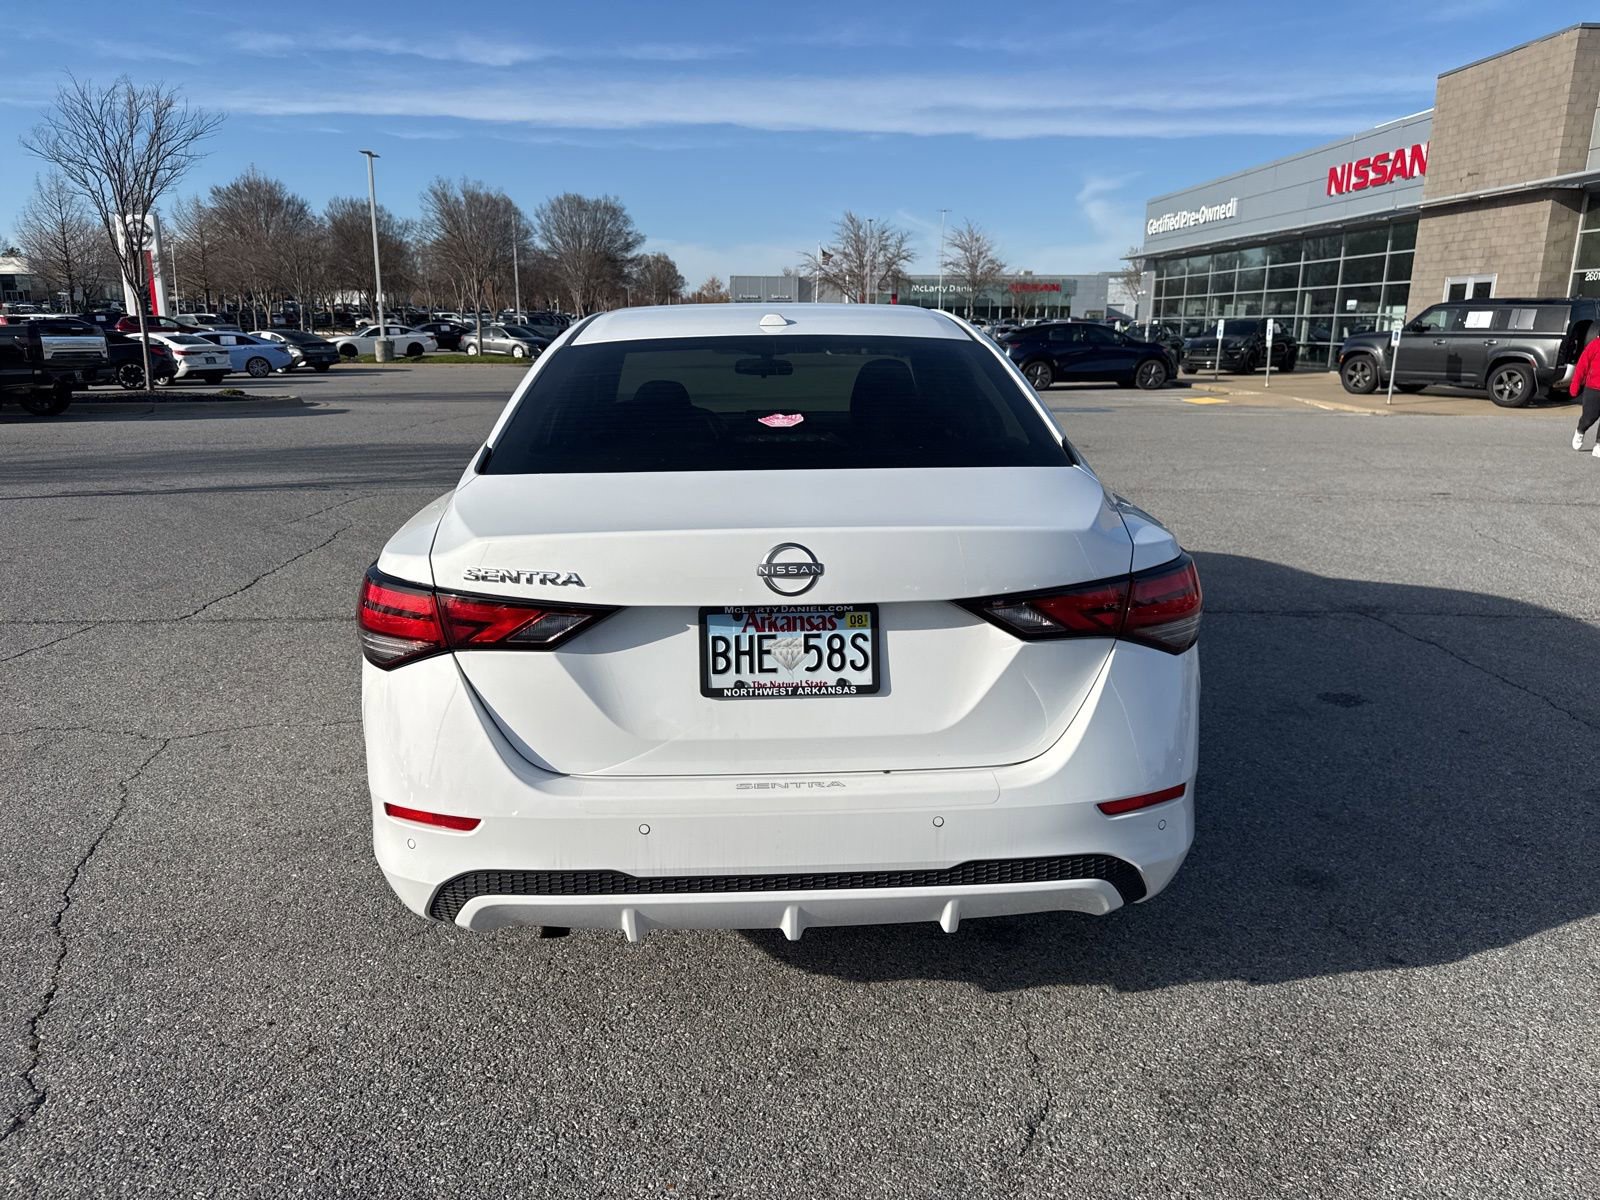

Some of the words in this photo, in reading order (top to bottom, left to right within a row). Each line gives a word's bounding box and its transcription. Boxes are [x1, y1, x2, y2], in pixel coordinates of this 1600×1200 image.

[1327, 141, 1430, 196] NISSAN
[1147, 212, 1181, 235] Certified
[1181, 197, 1238, 228] Pre-Owned
[911, 284, 948, 293] McLarty
[758, 565, 821, 575] NISSAN
[463, 566, 586, 588] SENTRA
[741, 612, 838, 633] Arkansas
[850, 614, 863, 625] 08
[711, 634, 778, 675] BHE
[803, 633, 870, 673] 58S
[769, 680, 803, 688] Natural
[805, 679, 828, 687] State
[724, 687, 794, 697] NORTHWEST
[797, 686, 857, 695] ARKANSAS
[736, 781, 846, 790] SENTRA
